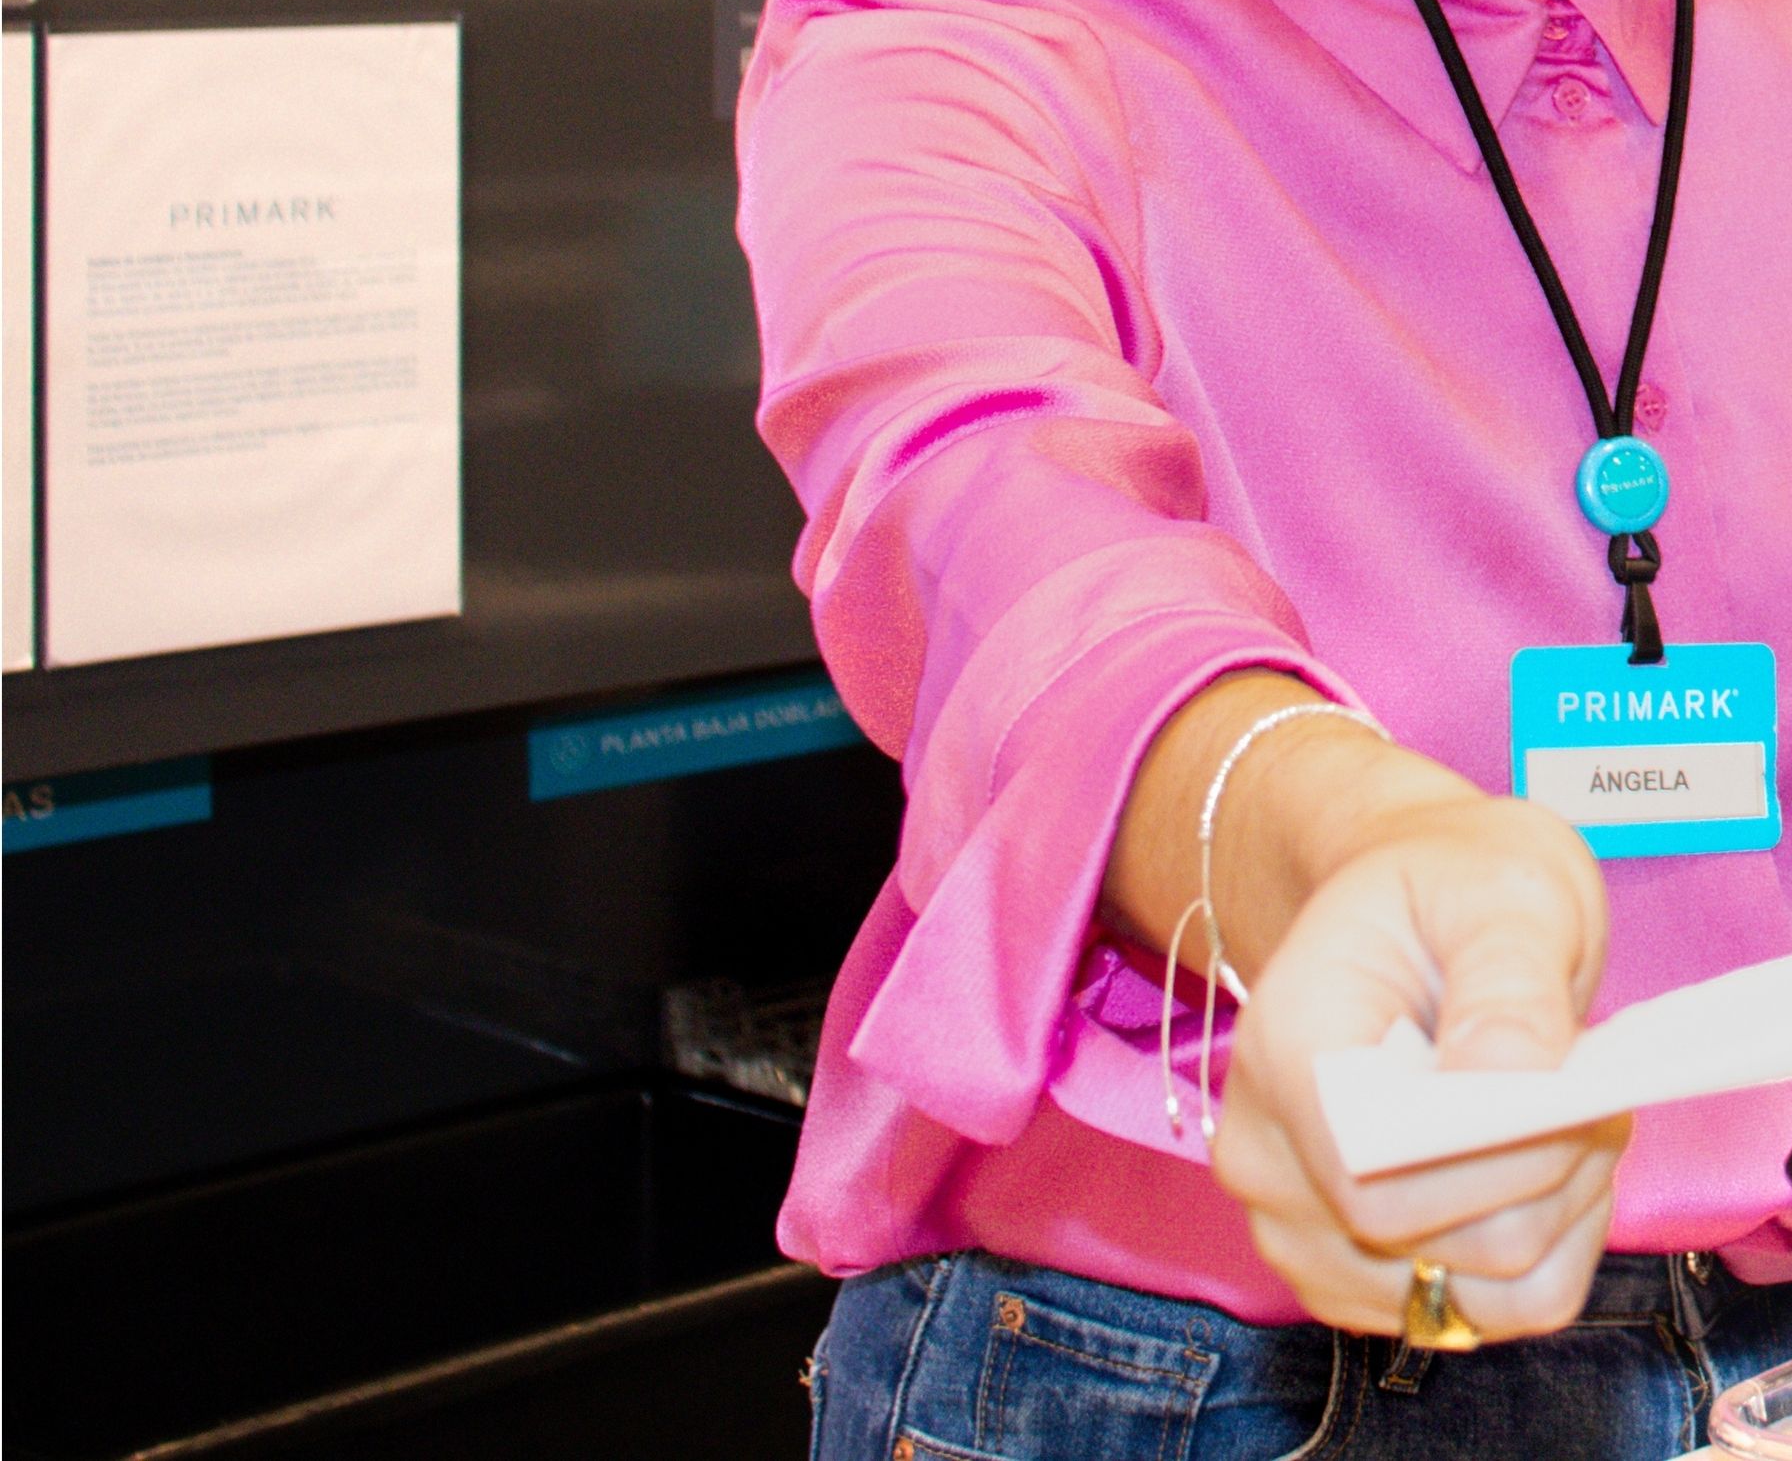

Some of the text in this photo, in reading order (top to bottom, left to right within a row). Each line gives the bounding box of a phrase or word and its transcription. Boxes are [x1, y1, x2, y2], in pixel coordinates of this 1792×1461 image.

[169, 196, 336, 229] PRIMARK
[1557, 689, 1735, 724] PRIMARK
[1589, 766, 1690, 794] ÁNGELA
